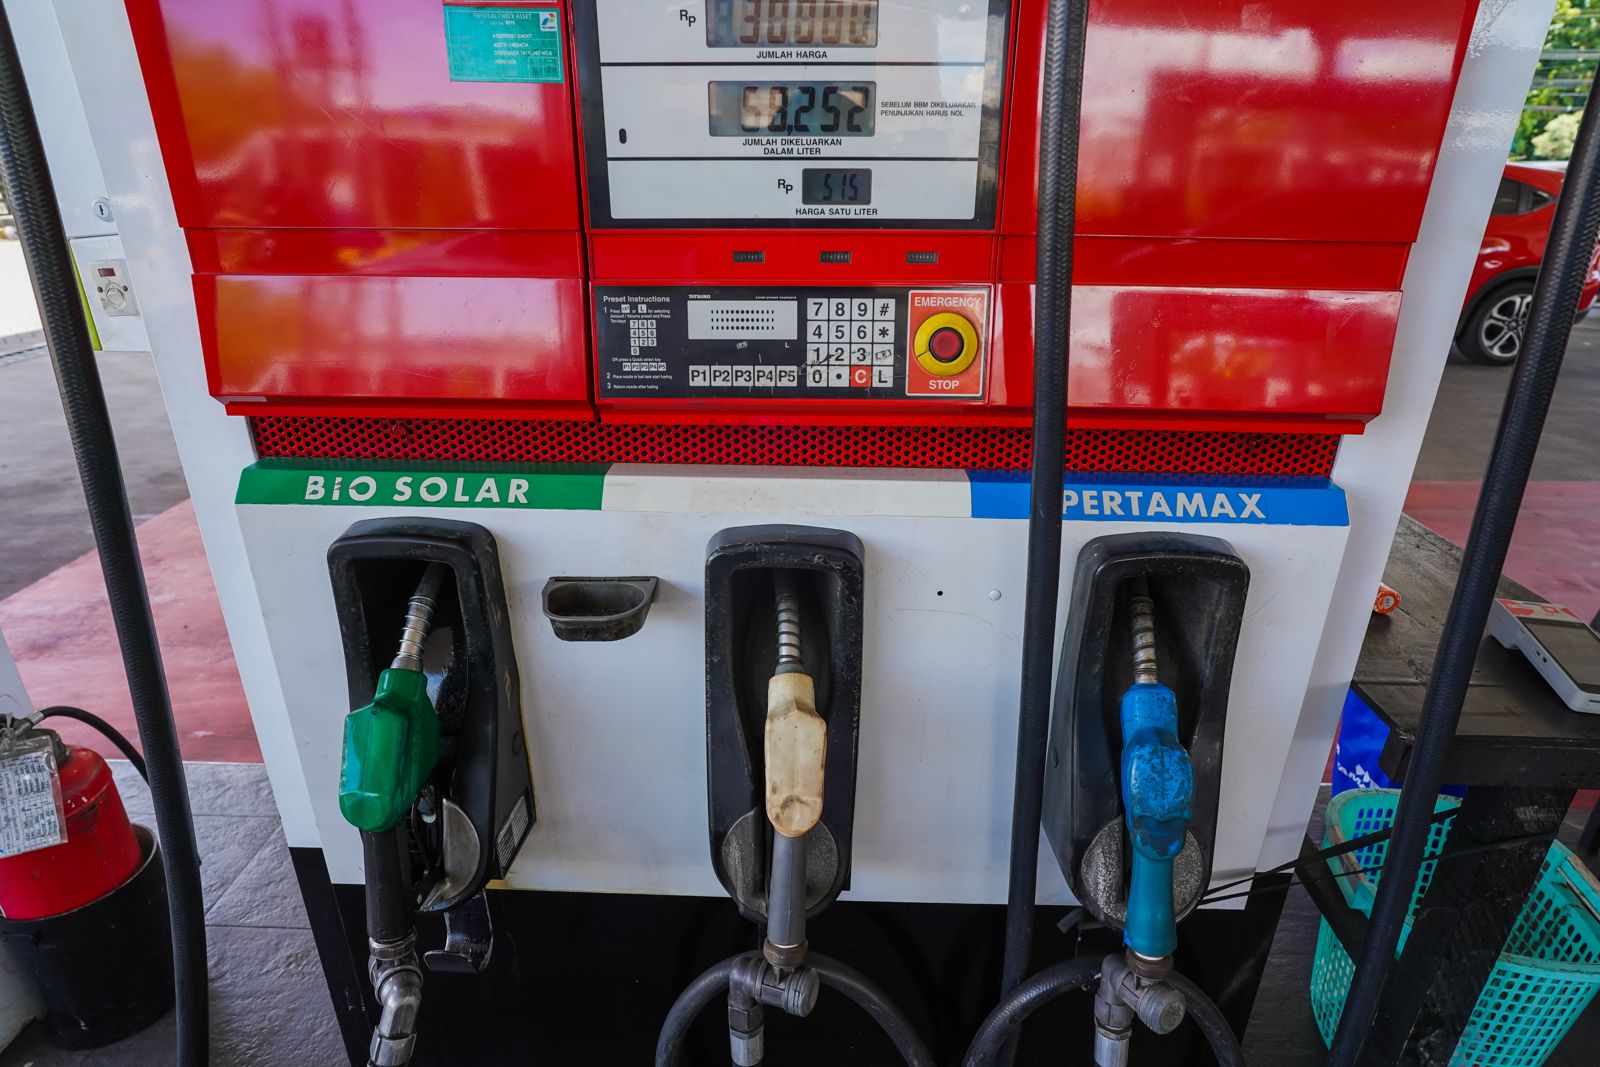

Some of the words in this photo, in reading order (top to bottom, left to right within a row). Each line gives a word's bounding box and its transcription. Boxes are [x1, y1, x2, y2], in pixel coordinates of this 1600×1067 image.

[756, 51, 793, 59] JUMLAH
[796, 51, 828, 59] HARGA
[742, 138, 777, 146] JUMLAH
[780, 138, 842, 146] DIKELUARKAN
[763, 147, 794, 155] DALAM
[797, 147, 821, 155] LITER
[914, 296, 981, 307] EMERGENCY
[813, 302, 823, 316] 7
[835, 302, 845, 316] 8
[858, 302, 868, 316] 9
[880, 303, 890, 316] #
[813, 325, 823, 339] 4
[835, 325, 845, 339] 5
[857, 325, 867, 339] 6
[813, 347, 820, 361] 1
[834, 347, 844, 361] 2
[857, 347, 867, 361] 3
[691, 370, 706, 382] P1
[713, 370, 730, 382] P2
[734, 370, 752, 382] P3
[756, 370, 774, 382] P4
[778, 370, 796, 382] P5
[812, 370, 822, 384] 0
[854, 370, 866, 384] C
[878, 370, 888, 384] L
[929, 380, 959, 390] STOP
[392, 475, 529, 504] SOLAR
[1062, 489, 1266, 518] PERTAMAX
